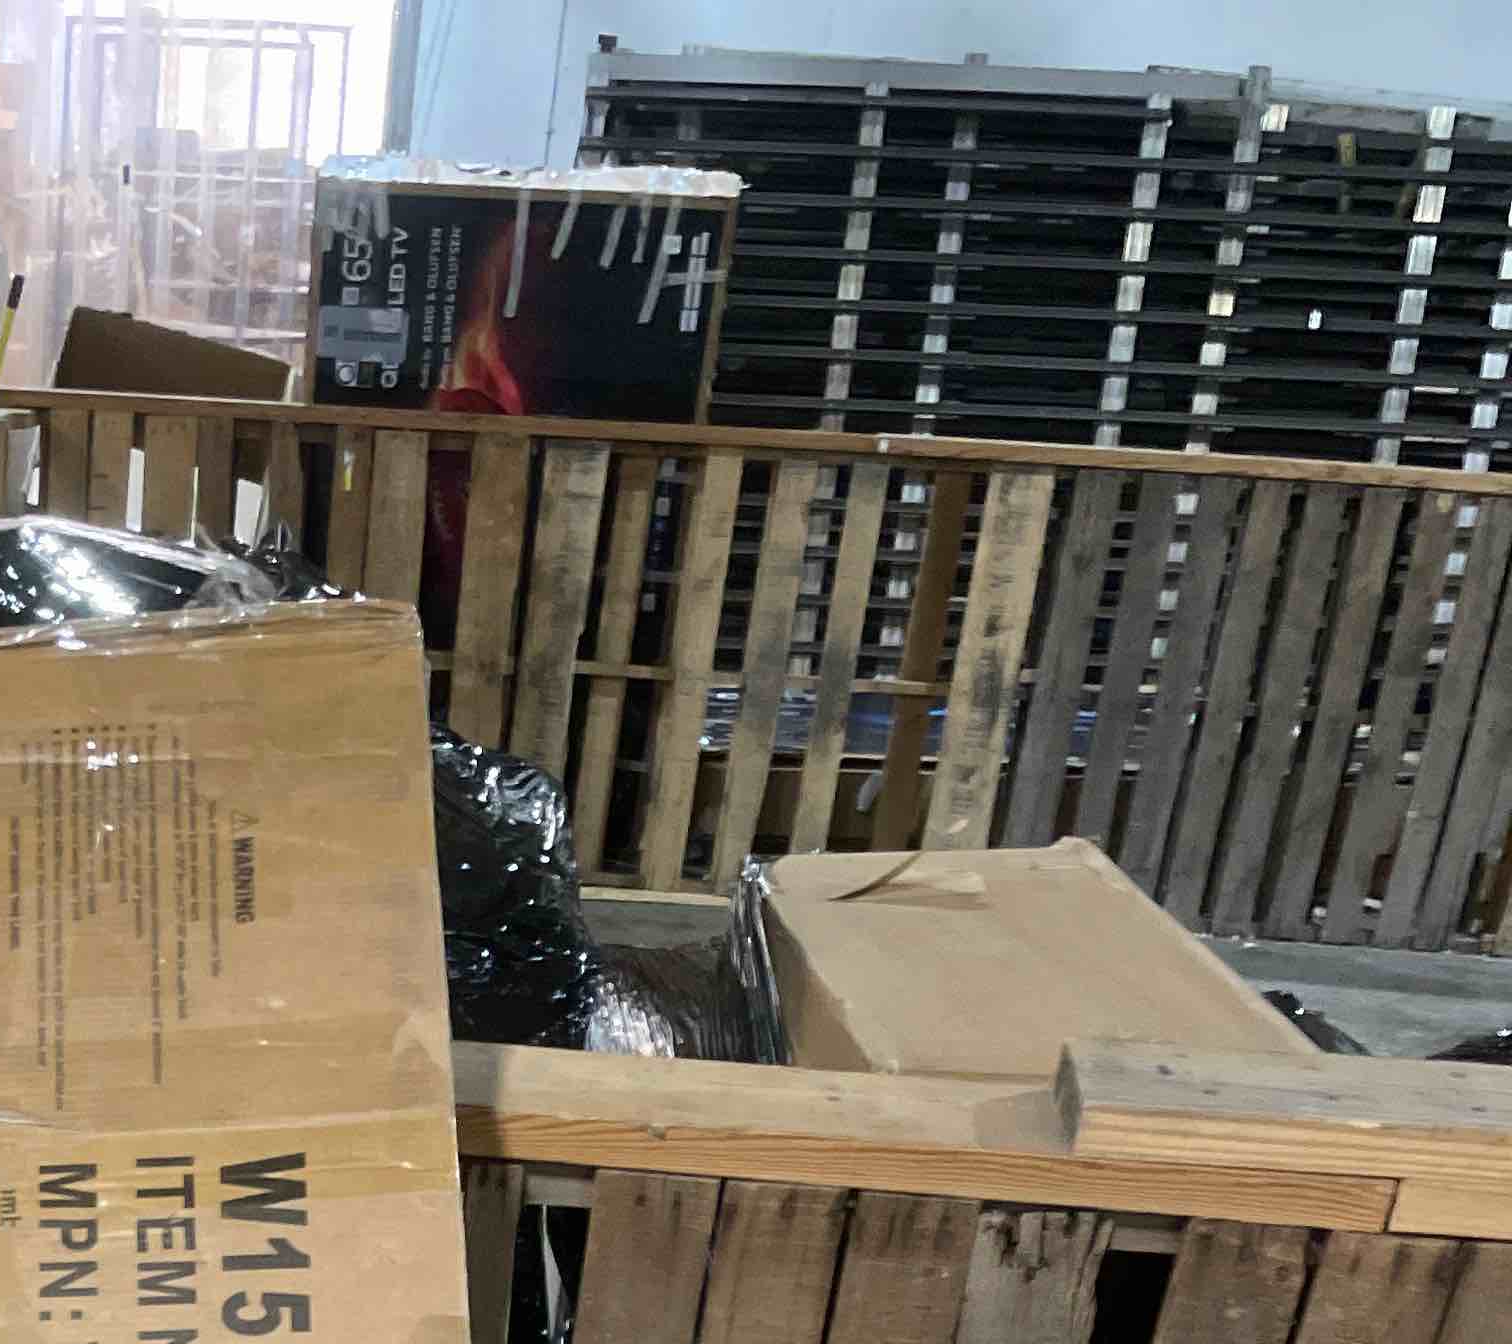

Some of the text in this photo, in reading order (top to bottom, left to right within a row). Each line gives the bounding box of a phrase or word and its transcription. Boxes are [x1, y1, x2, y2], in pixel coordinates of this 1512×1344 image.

[391, 226, 409, 256] TV
[232, 836, 256, 924] WARNING
[39, 1163, 99, 1321] MPN:
[135, 1156, 197, 1306] ITEM
